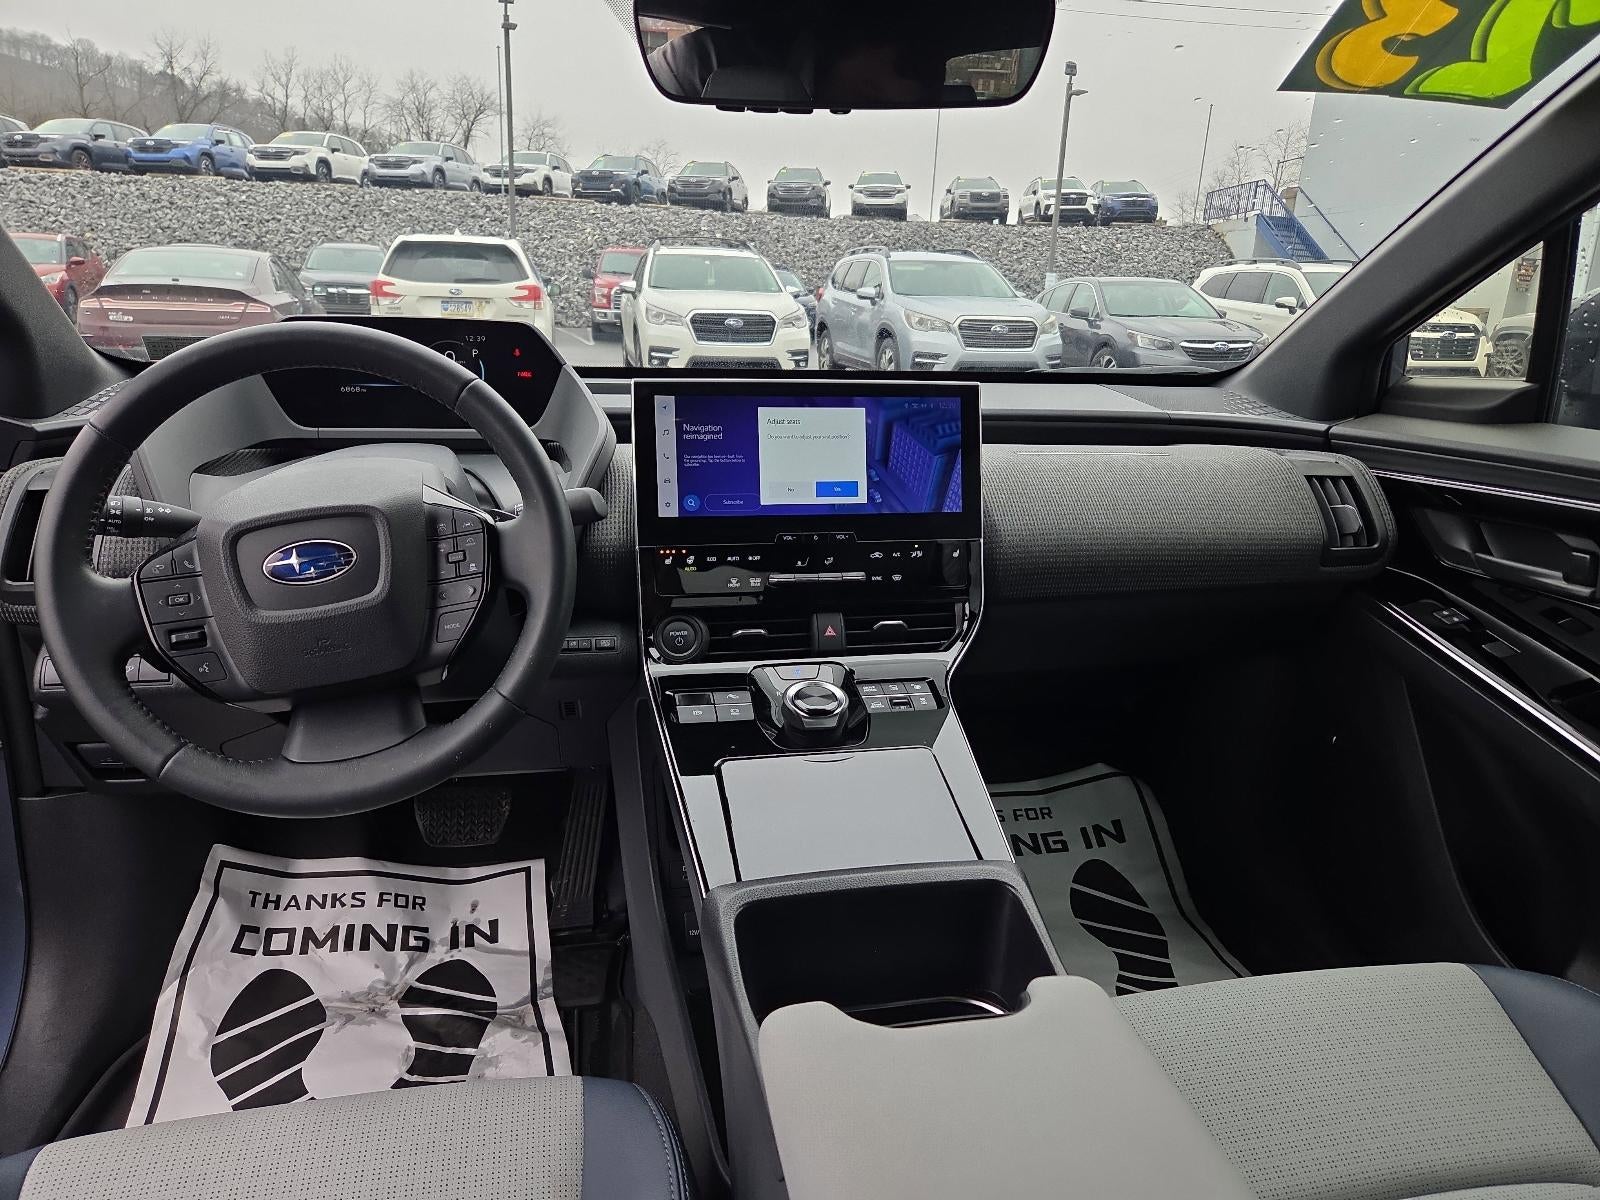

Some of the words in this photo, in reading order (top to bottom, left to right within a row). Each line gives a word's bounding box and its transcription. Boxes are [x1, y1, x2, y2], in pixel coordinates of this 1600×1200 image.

[472, 348, 479, 358] P
[683, 423, 723, 433] Navigation
[766, 418, 785, 426] Adjust
[683, 433, 723, 441] reimagined
[1012, 806, 1053, 822] FOR
[1080, 818, 1127, 850] IN
[248, 890, 367, 912] THANKS
[376, 891, 427, 912] FOR
[230, 922, 431, 957] COMING
[449, 918, 499, 951] IN
